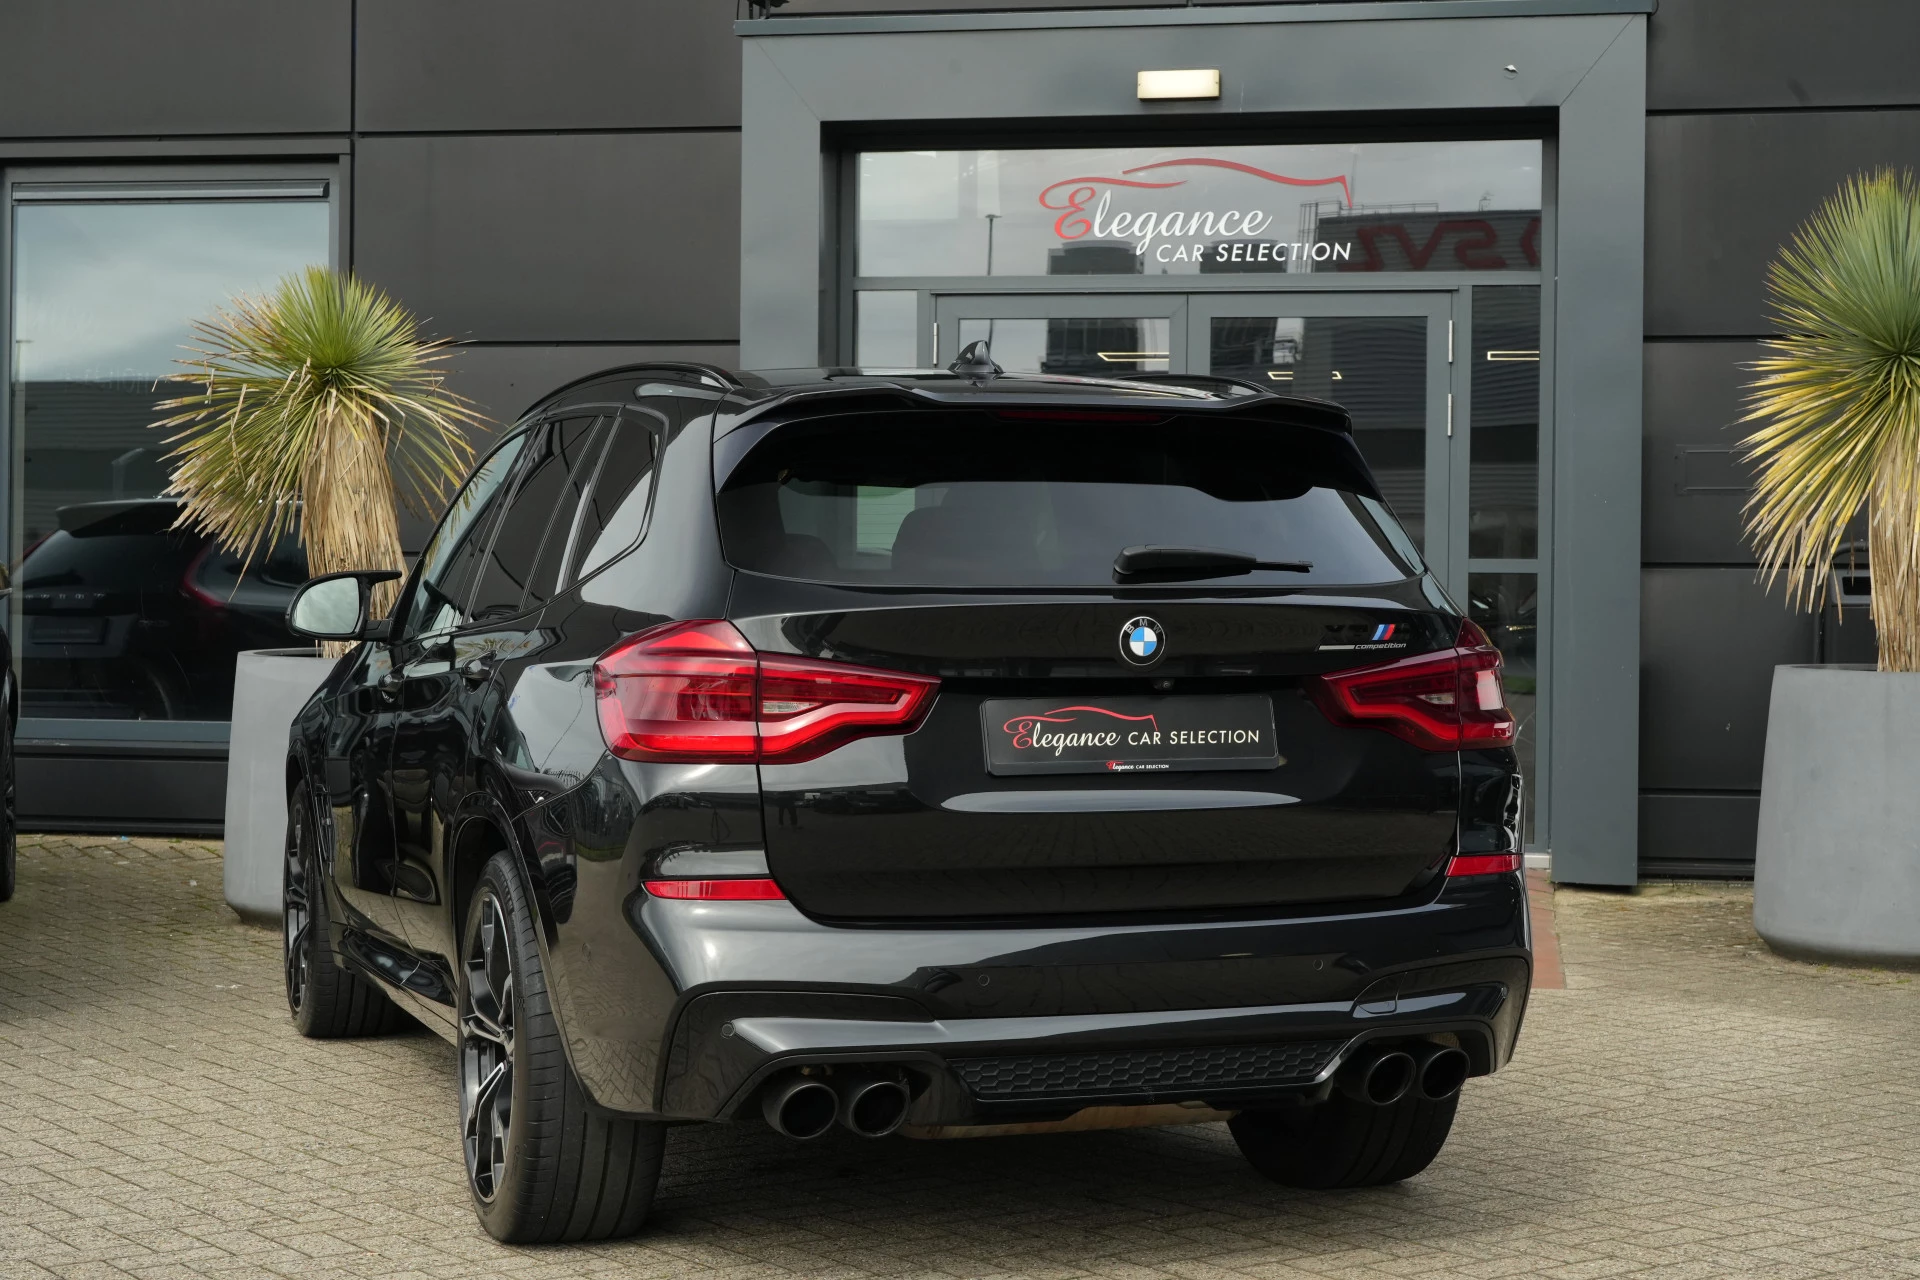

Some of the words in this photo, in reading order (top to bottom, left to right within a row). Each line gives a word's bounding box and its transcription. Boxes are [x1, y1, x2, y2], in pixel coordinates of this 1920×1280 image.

[1038, 177, 1273, 256] Elegance
[1156, 244, 1204, 262] CAR
[1216, 242, 1352, 262] SELECTION
[1003, 715, 1121, 756] Elegance
[1127, 731, 1161, 745] CAR
[1169, 730, 1260, 744] SELECTION
[1105, 761, 1134, 772] Elegance
